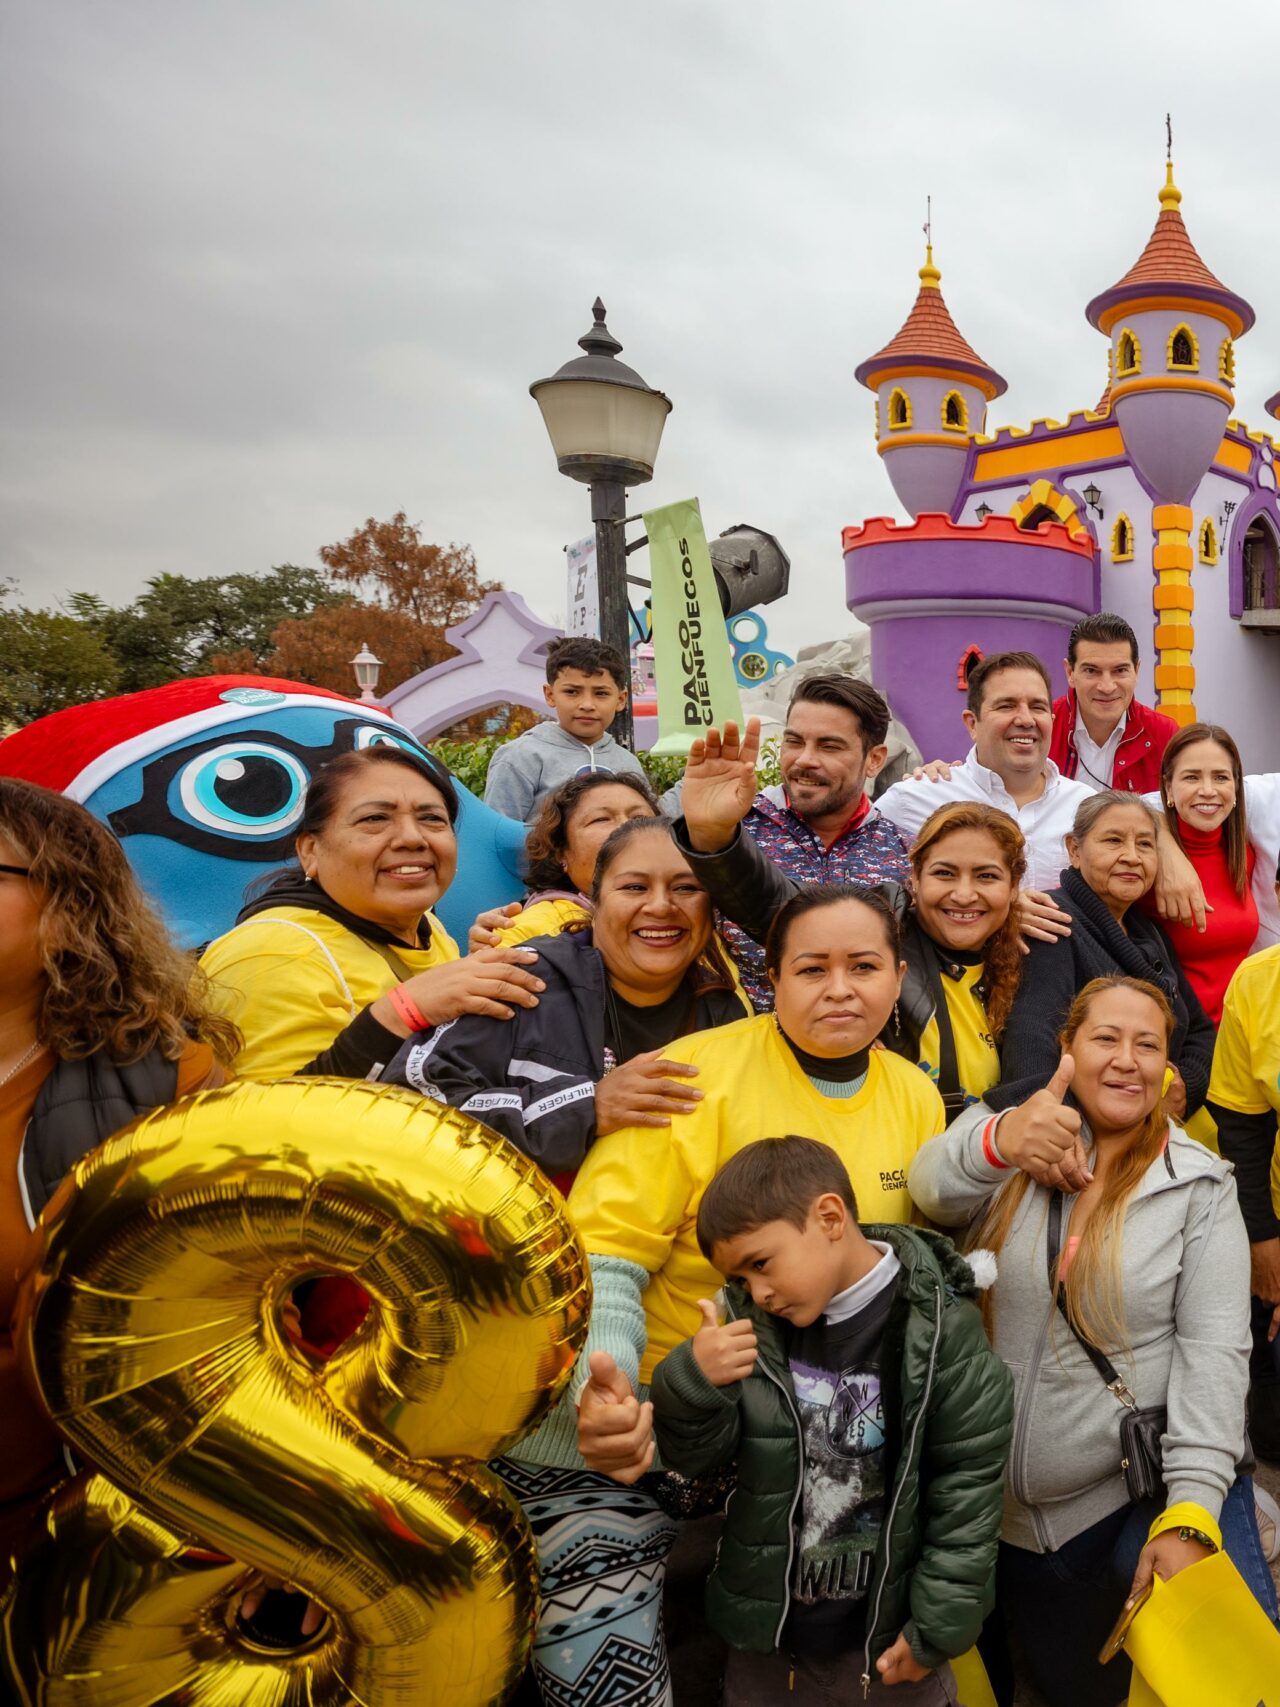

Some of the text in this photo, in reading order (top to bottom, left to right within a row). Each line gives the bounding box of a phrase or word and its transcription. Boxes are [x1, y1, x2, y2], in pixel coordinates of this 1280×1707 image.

[678, 619, 701, 726] PACO
[680, 537, 714, 726] CIENFUEGOS
[538, 1086, 593, 1112] HILFIGER
